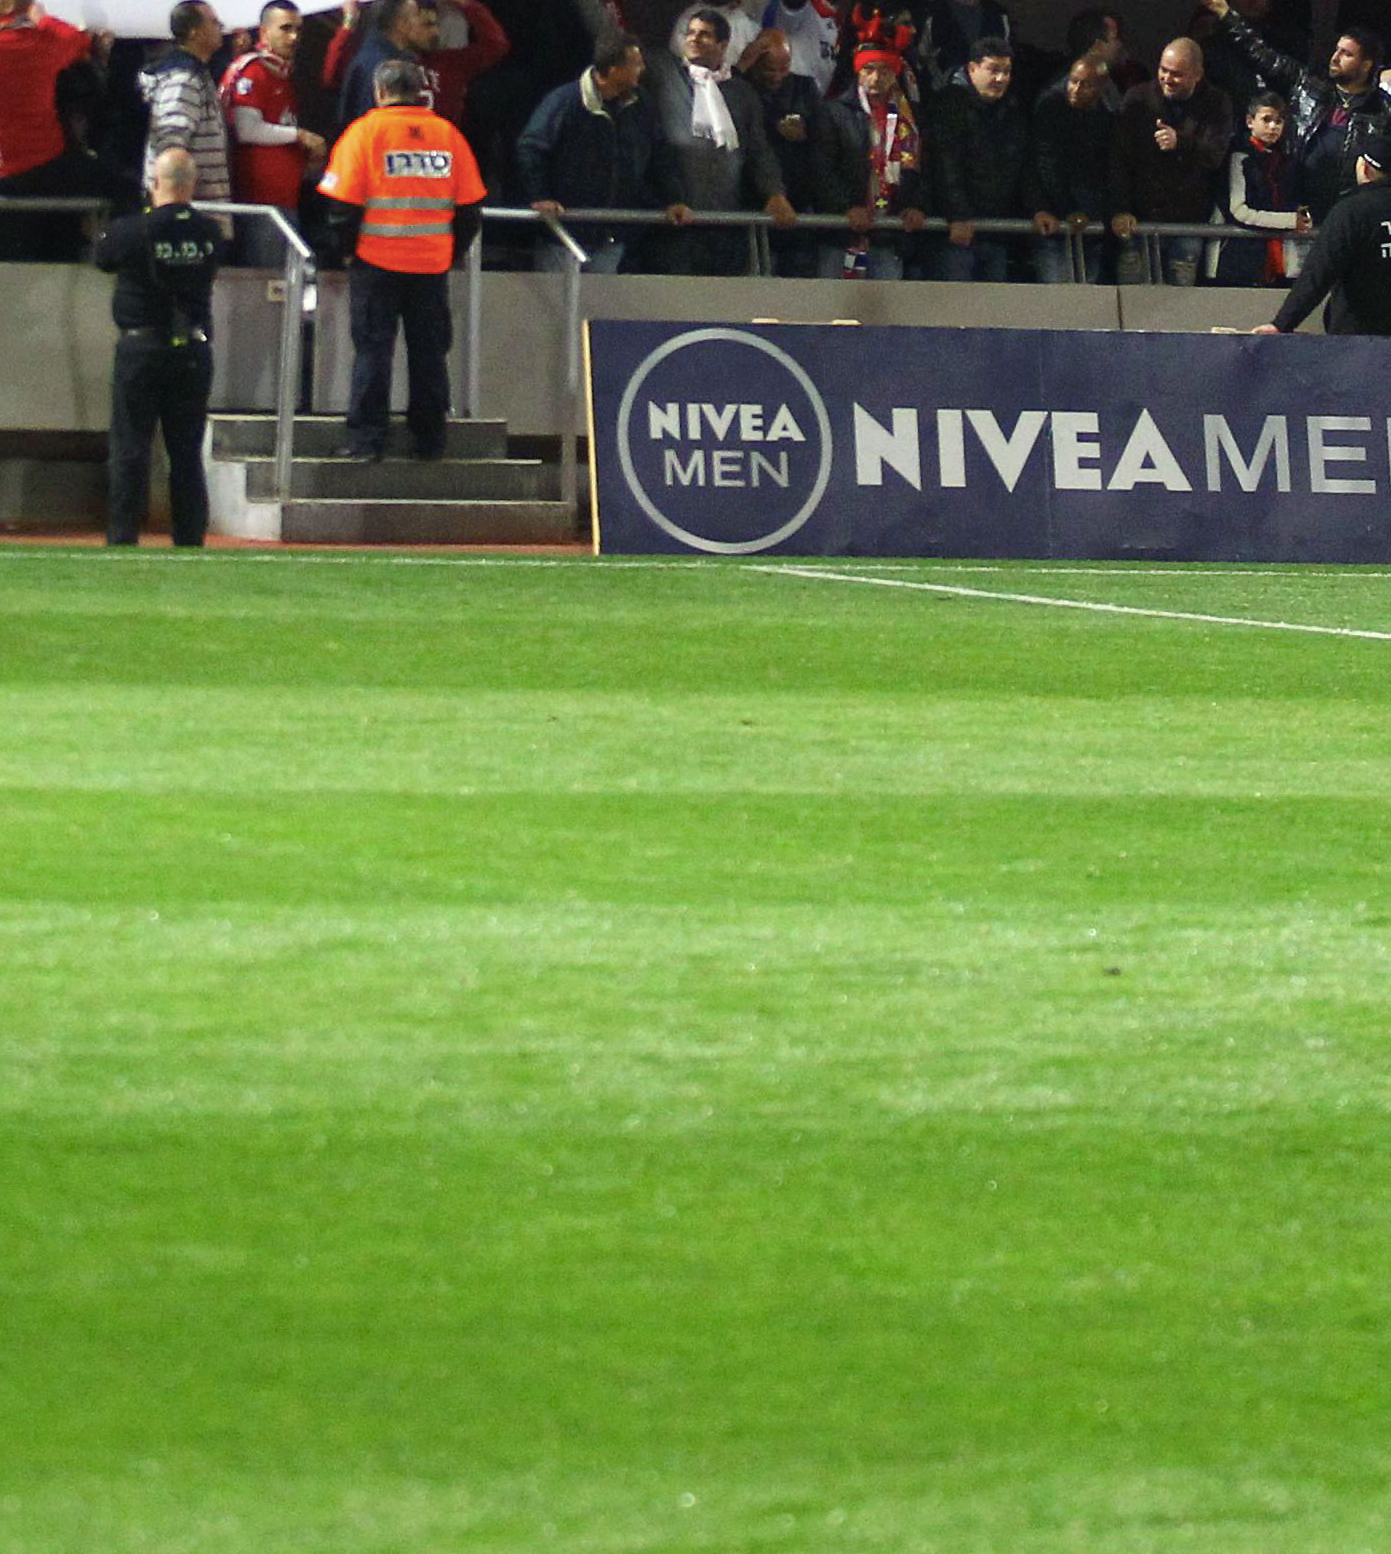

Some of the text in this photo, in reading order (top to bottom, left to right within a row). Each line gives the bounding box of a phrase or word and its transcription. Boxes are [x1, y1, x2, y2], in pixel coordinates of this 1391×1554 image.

[386, 152, 448, 175] סדרן
[648, 401, 806, 442] NIVEA
[663, 450, 789, 488] MEN
